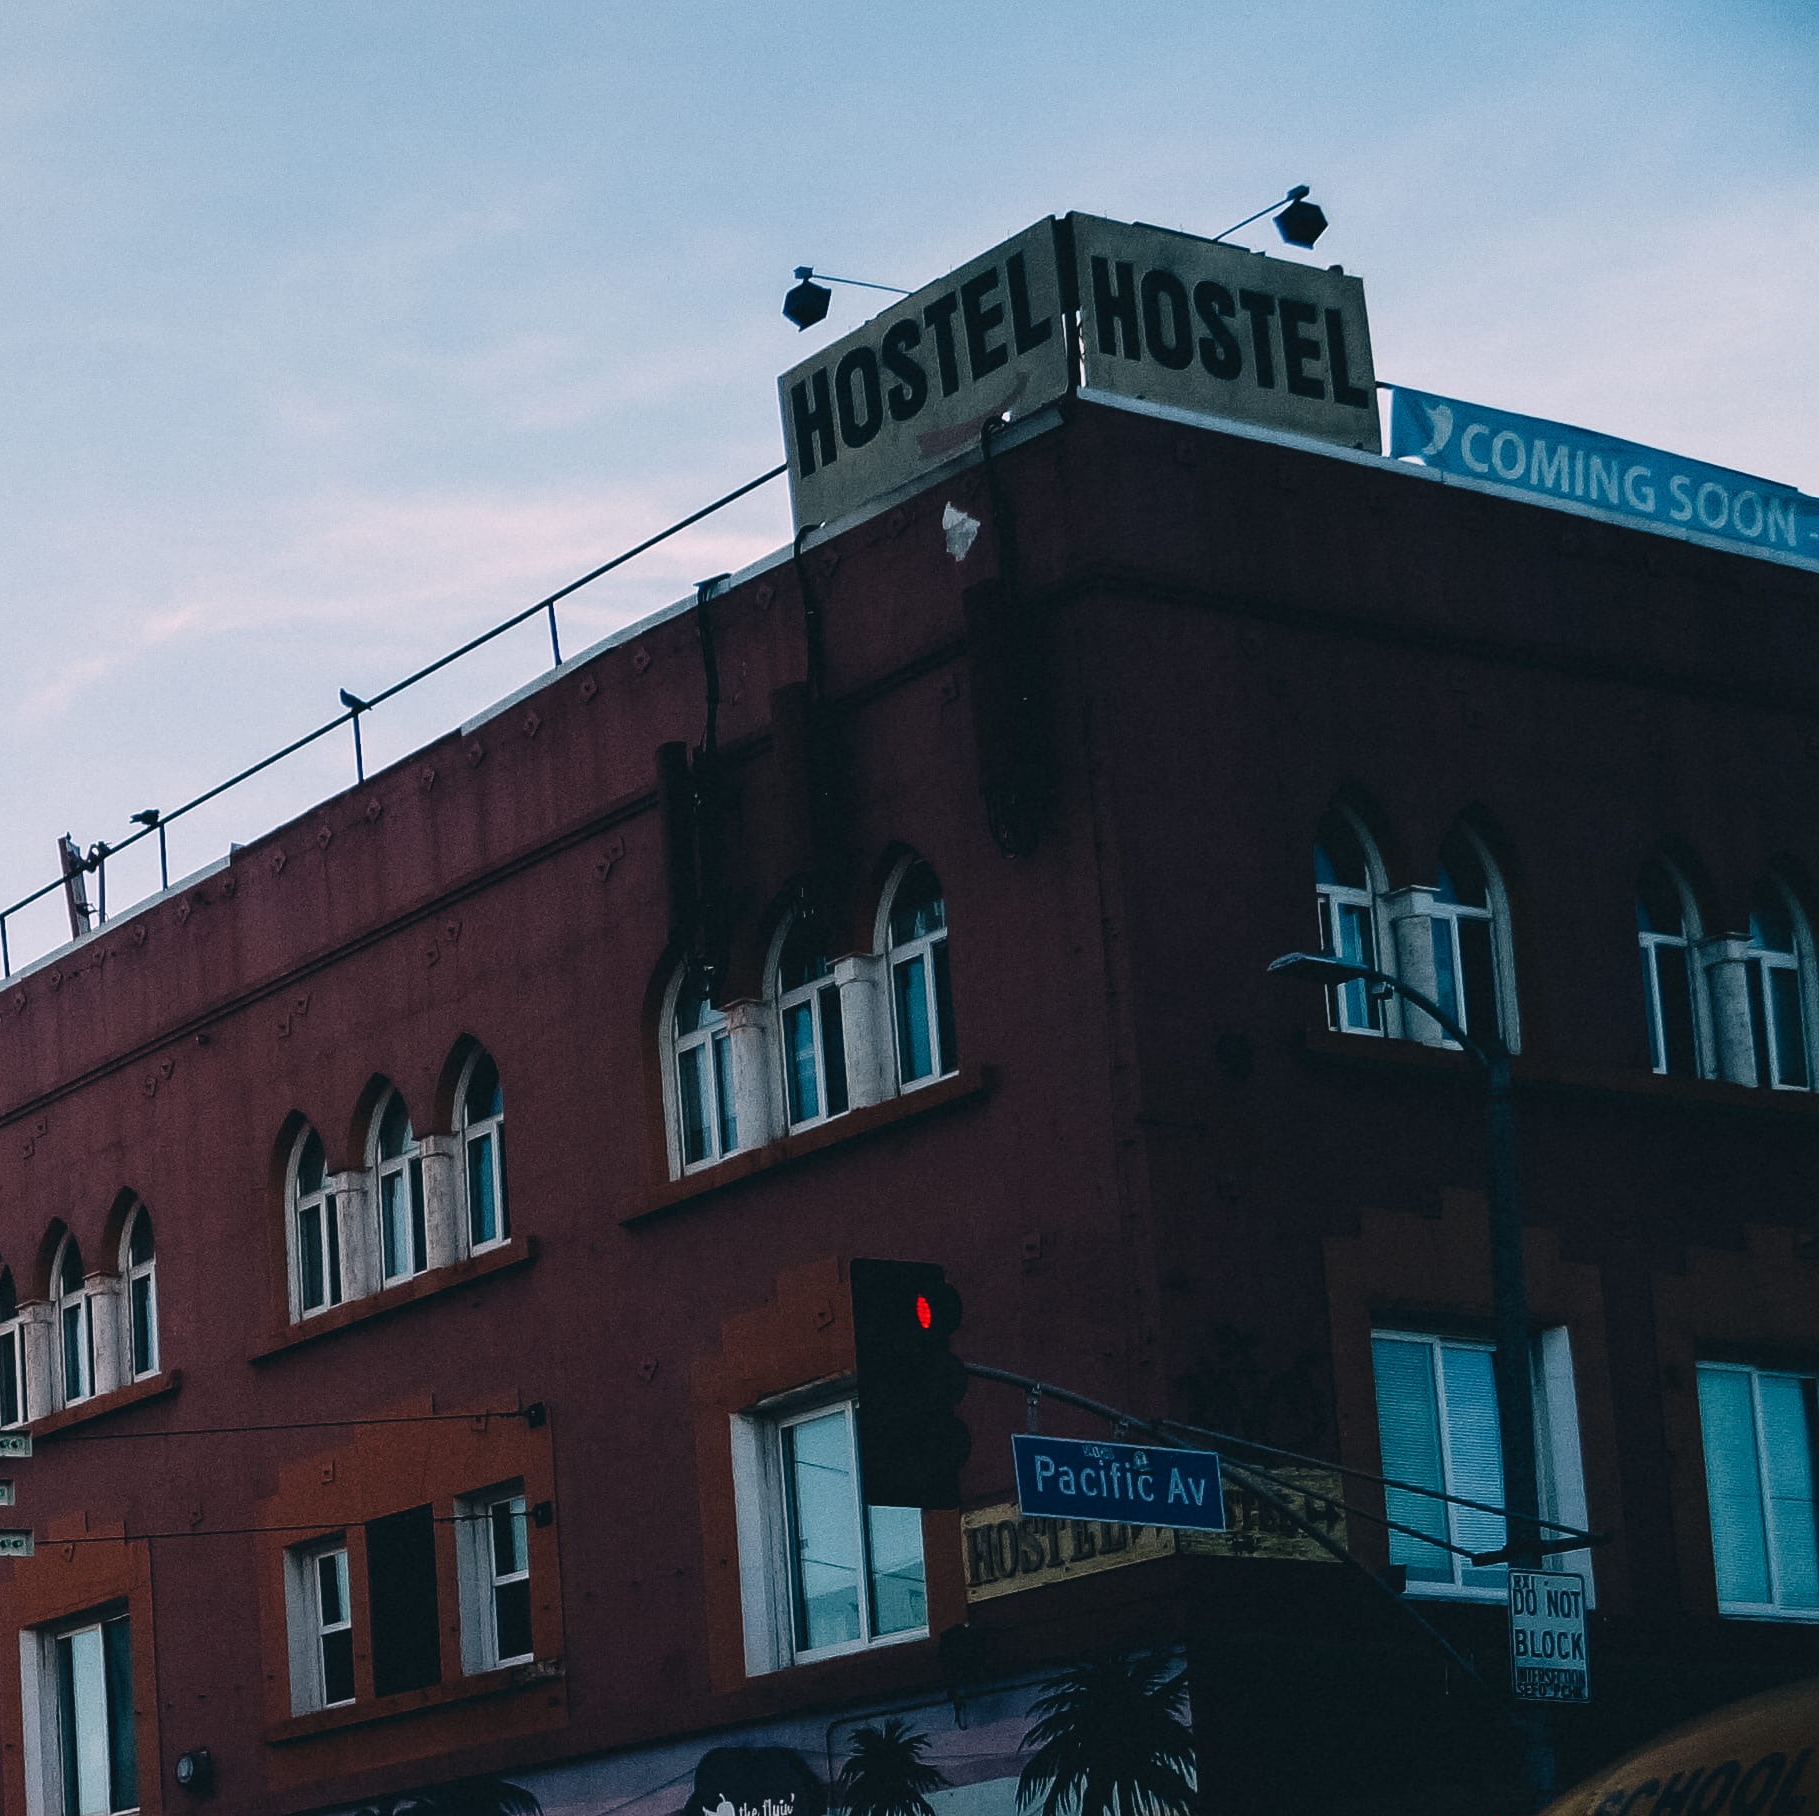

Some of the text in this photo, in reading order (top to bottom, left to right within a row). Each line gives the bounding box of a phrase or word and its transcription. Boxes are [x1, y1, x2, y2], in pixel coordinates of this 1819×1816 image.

[791, 251, 1053, 480] HOSTEL
[1091, 255, 1369, 409] HOSTEL
[1463, 424, 1797, 547] COMING SOON
[1034, 1455, 1205, 1506] Pacific Av
[1513, 1588, 1581, 1618] DO NOT
[1515, 1629, 1584, 1660] BLOCK
